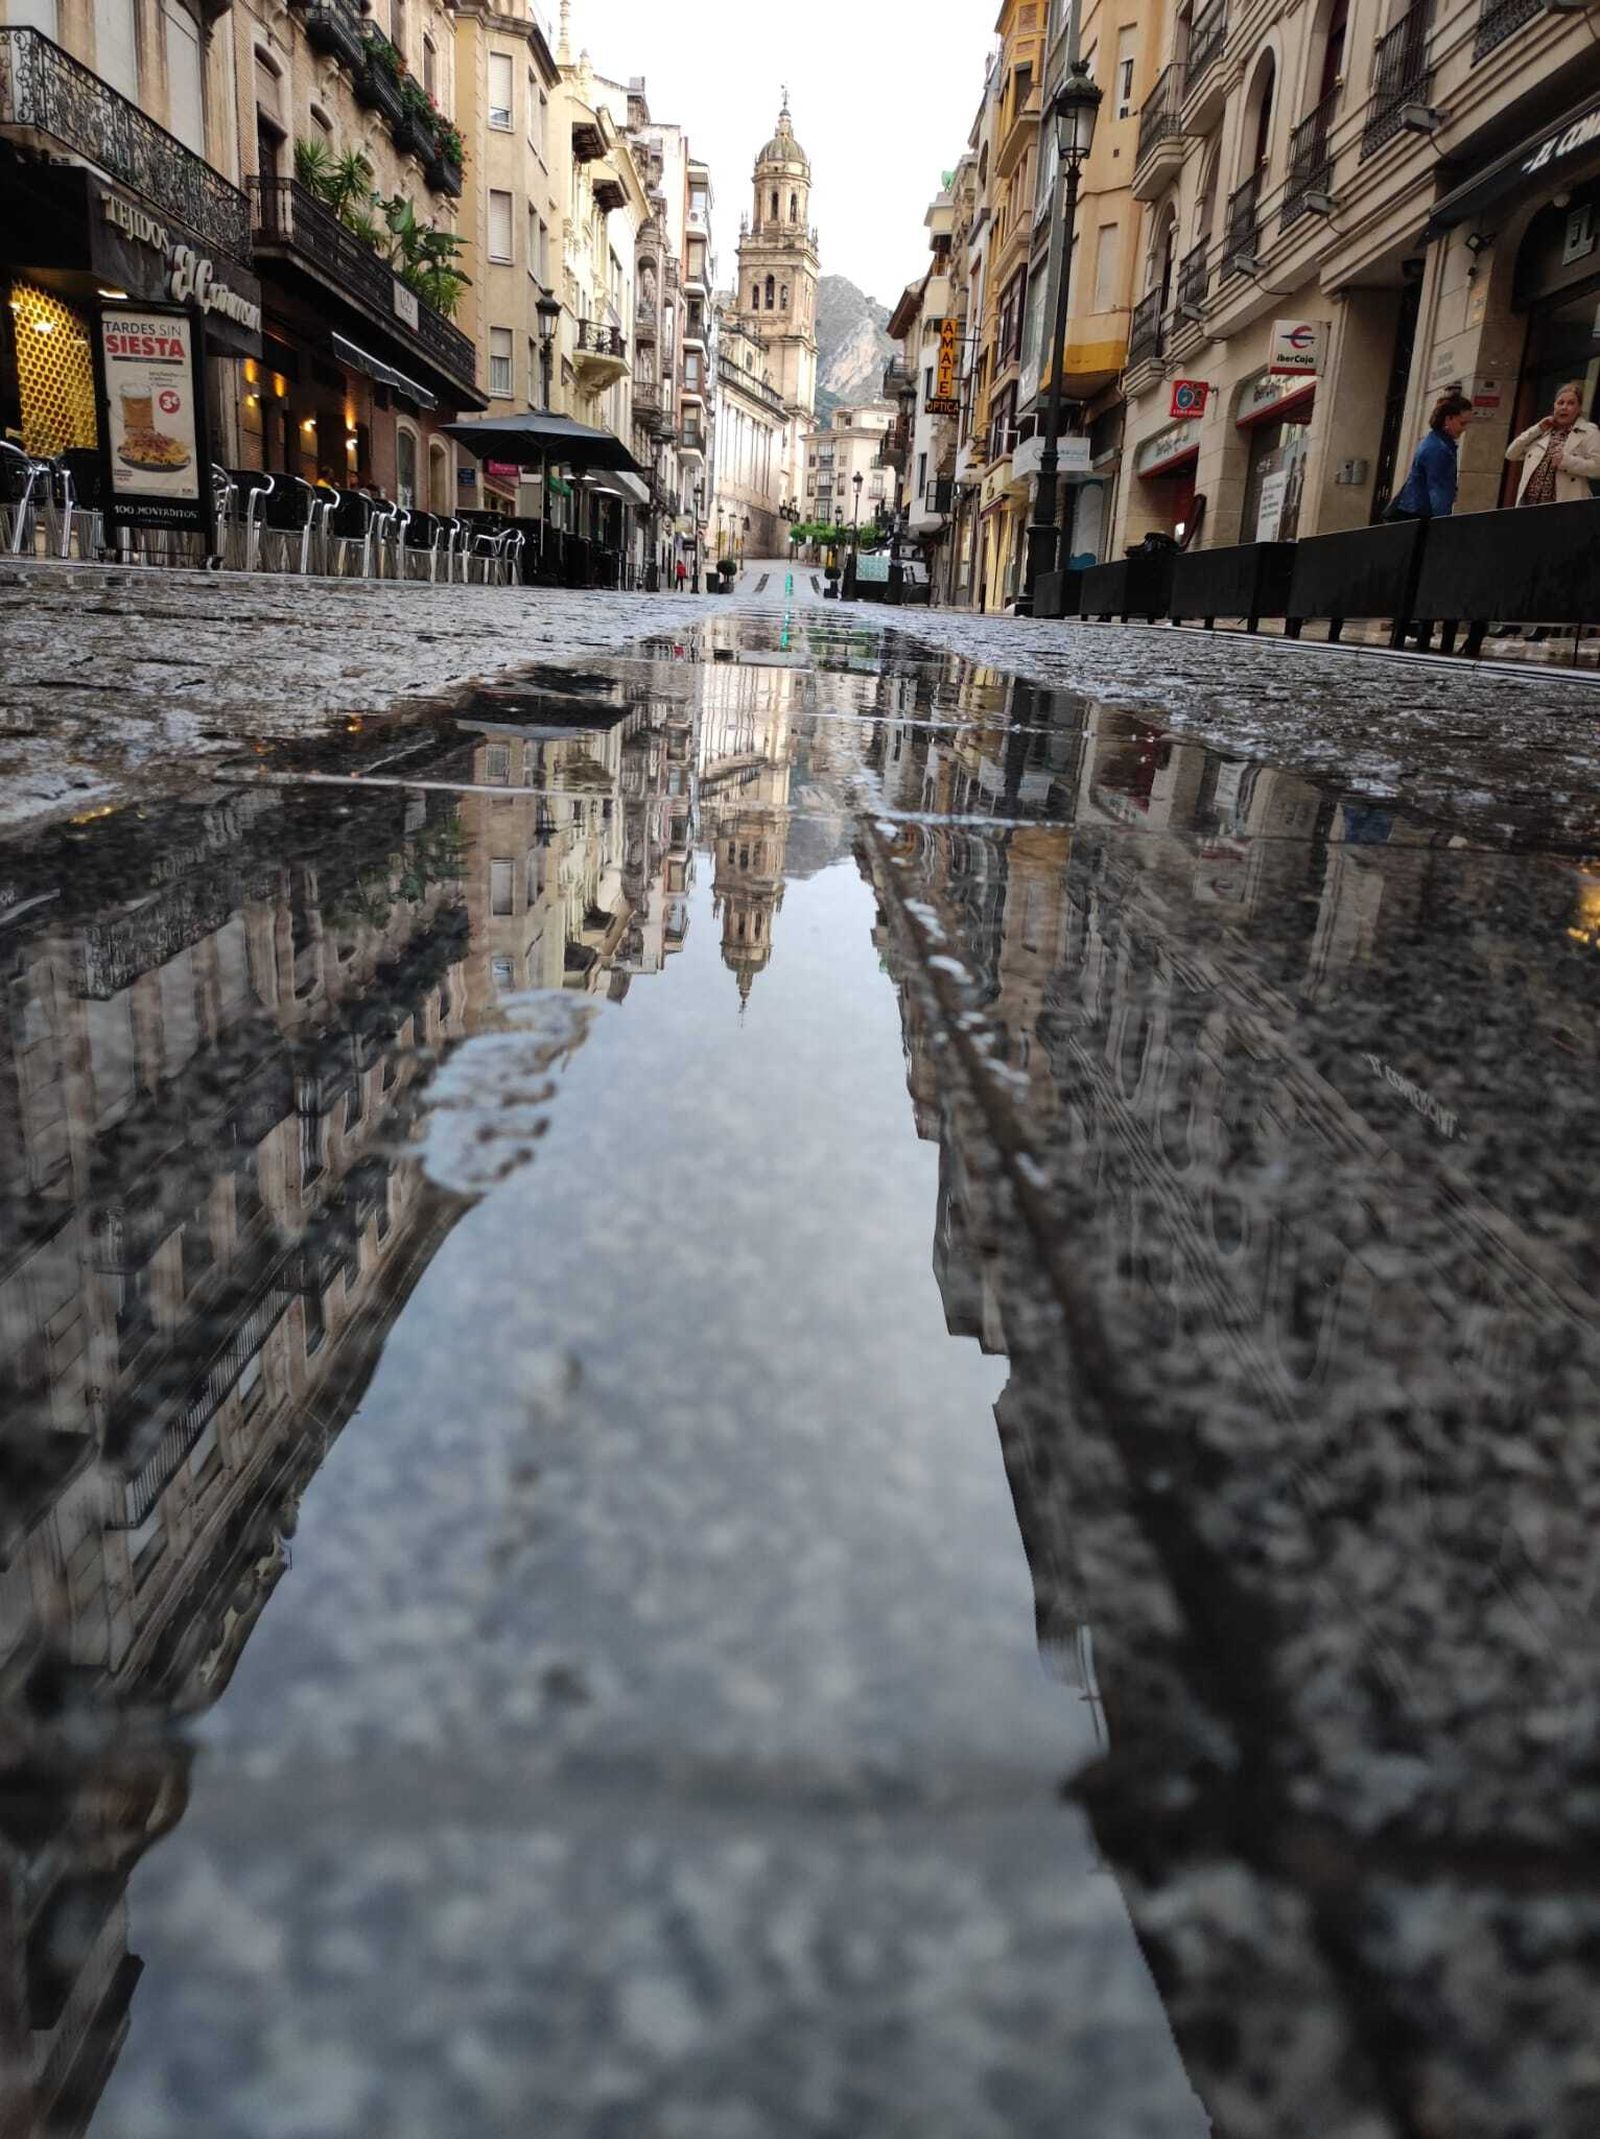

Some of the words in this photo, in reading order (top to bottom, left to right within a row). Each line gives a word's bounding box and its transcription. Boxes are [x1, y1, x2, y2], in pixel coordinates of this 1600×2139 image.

[101, 191, 170, 255] TEJIDOS
[171, 245, 196, 302] El
[102, 320, 156, 336] TARDES
[159, 323, 182, 338] SIN
[105, 334, 186, 358] SIESTA
[939, 321, 954, 395] AMATE
[926, 400, 960, 413] OPTICA
[113, 504, 135, 516] 100
[137, 505, 199, 519] MONTADITOS
